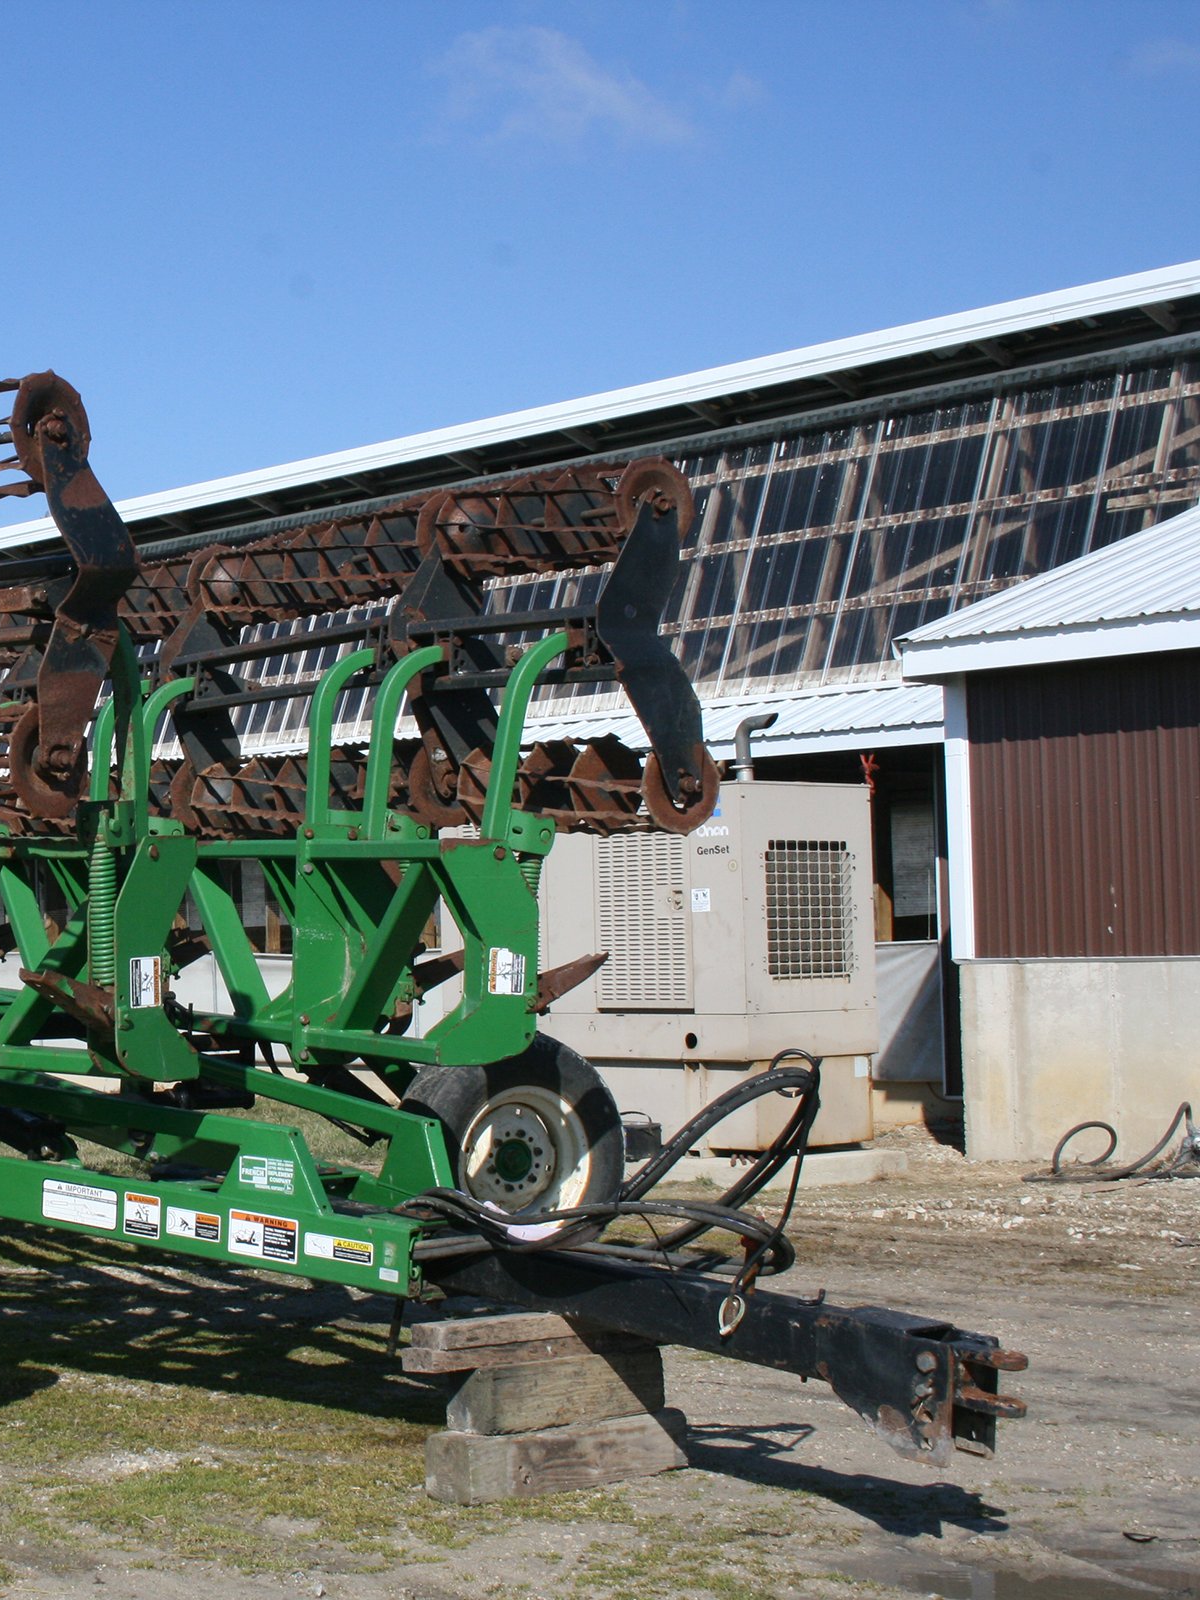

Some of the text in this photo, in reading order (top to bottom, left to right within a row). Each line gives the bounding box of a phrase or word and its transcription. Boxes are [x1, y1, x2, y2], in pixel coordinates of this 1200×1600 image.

[696, 824, 729, 837] Onan
[697, 845, 730, 855] GenSet
[242, 1168, 265, 1177] FRENCH
[65, 1184, 103, 1197] IMPORTANT
[132, 1194, 158, 1205] WARNING
[254, 1217, 288, 1228] WARNING
[343, 1241, 369, 1251] CAUTION
